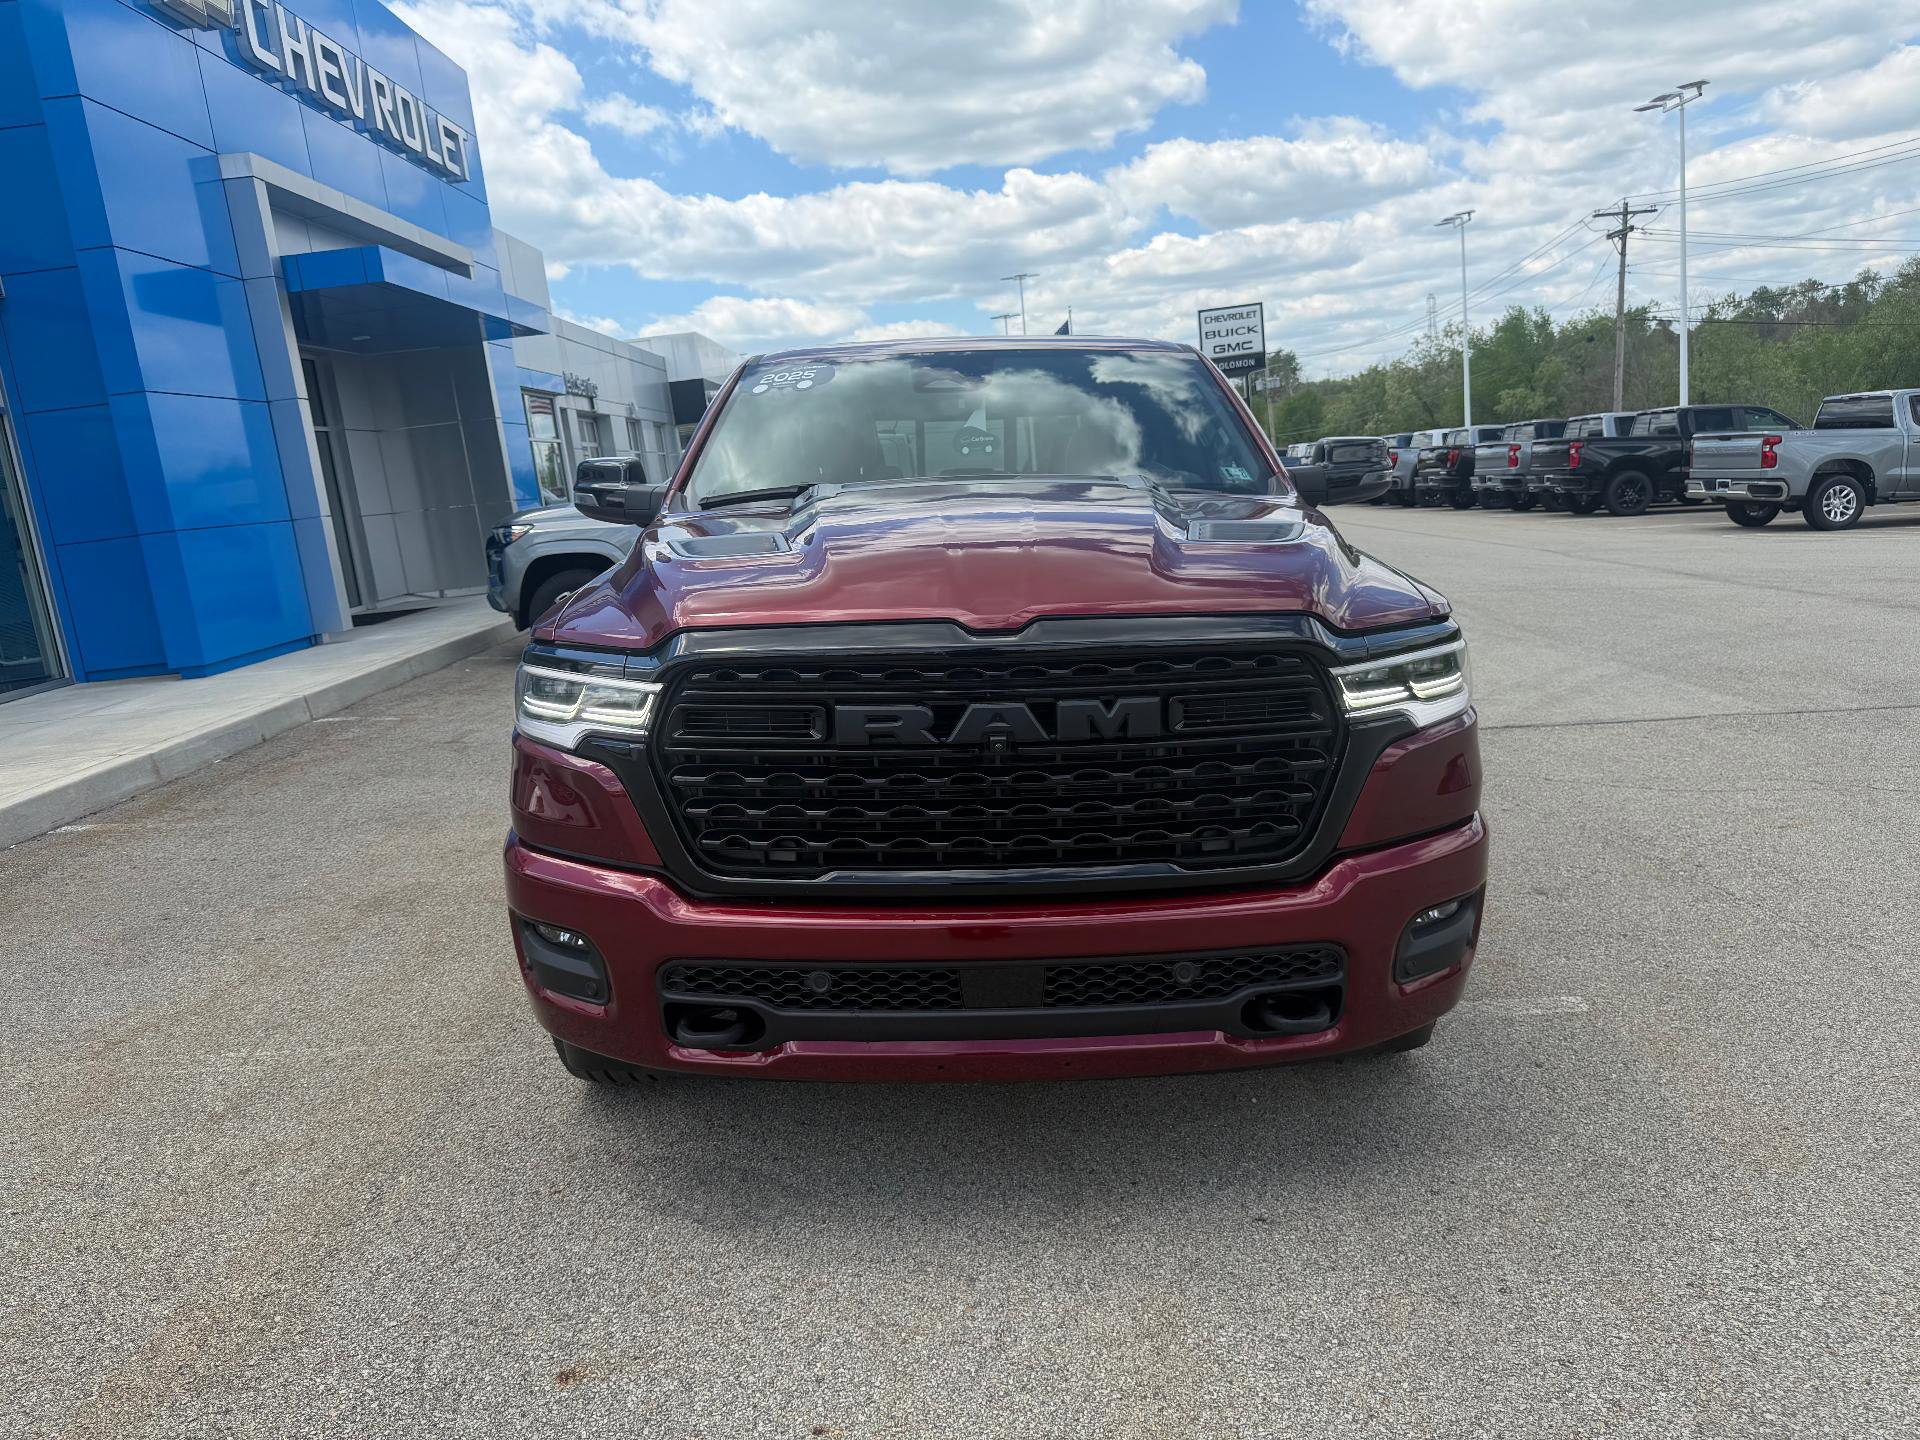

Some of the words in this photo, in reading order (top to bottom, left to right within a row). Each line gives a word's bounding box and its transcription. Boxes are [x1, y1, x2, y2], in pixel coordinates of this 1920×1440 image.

[243, 0, 470, 181] CHEVROLET
[1204, 310, 1258, 325] CHEVROLET
[1205, 325, 1259, 340] BUICK
[1213, 341, 1254, 354] GMC
[1216, 358, 1256, 371] OLOMON
[759, 369, 817, 384] 2025
[834, 696, 1161, 745] RAM
